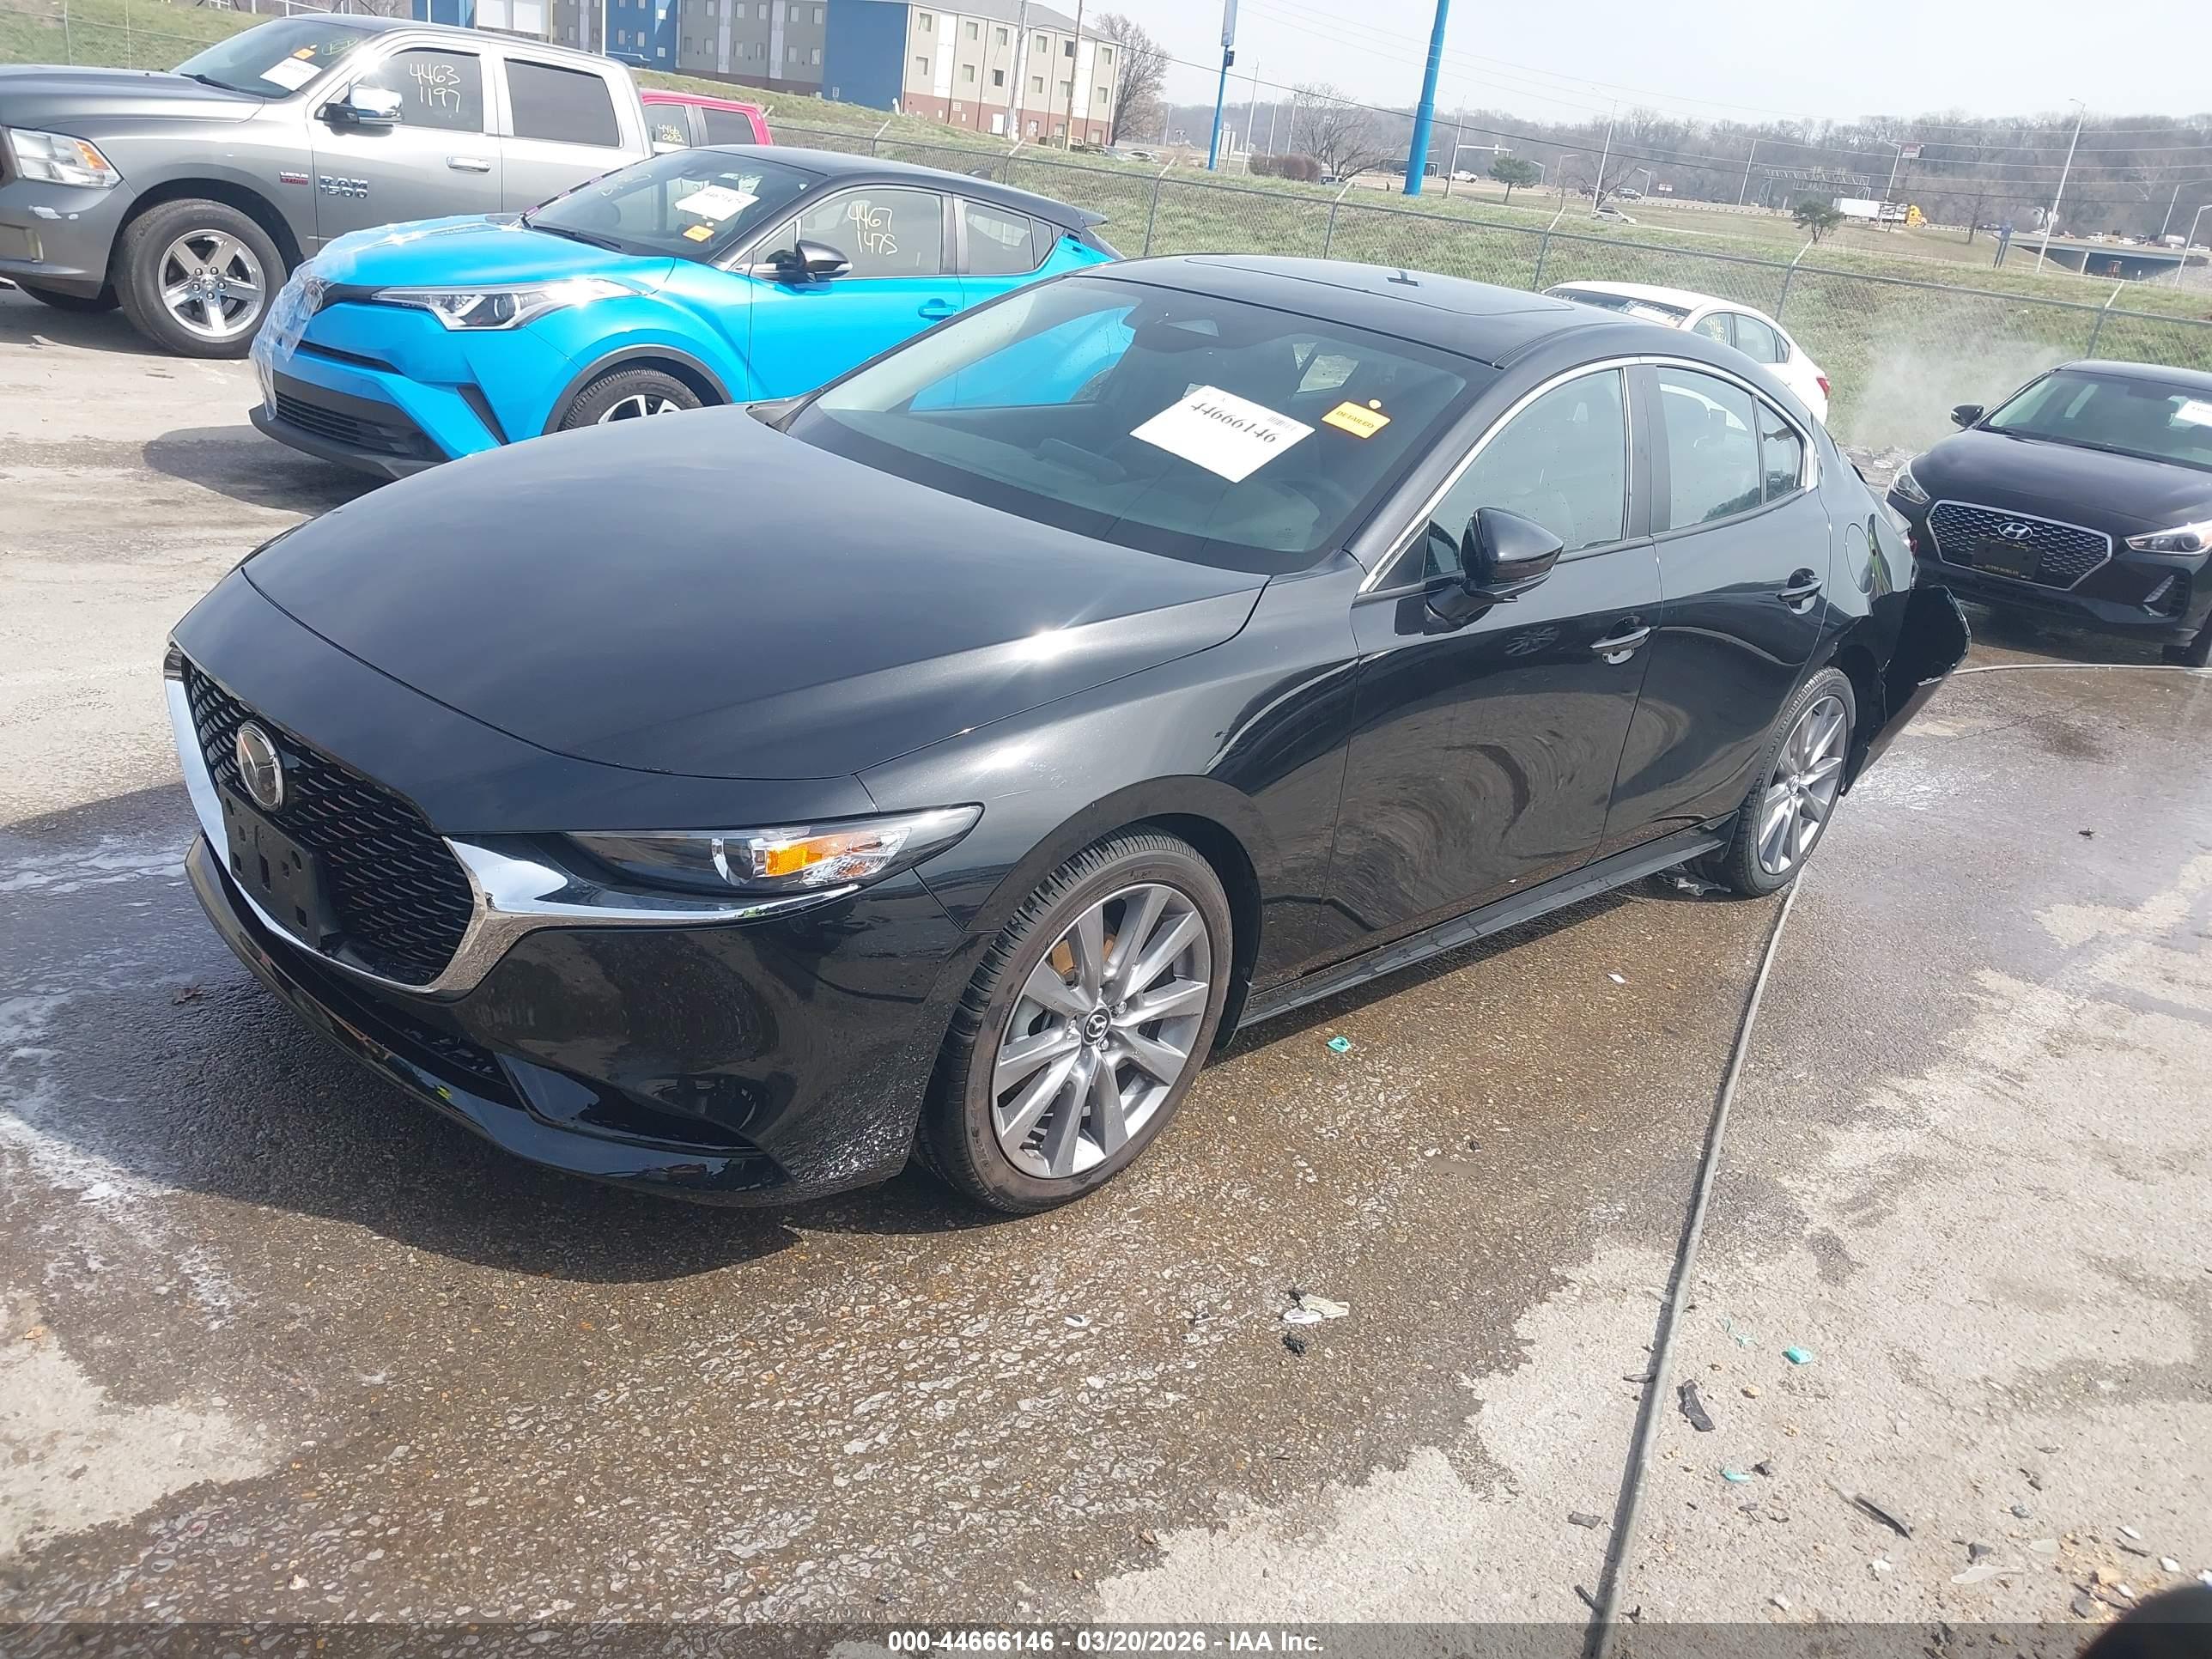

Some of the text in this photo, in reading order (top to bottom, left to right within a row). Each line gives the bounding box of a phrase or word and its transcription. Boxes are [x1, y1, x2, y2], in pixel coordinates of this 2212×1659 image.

[410, 63, 461, 86] 4463
[420, 86, 461, 113] 1197
[319, 174, 368, 190] RAM
[319, 184, 368, 199] 1500
[847, 204, 893, 234] 4467
[857, 230, 898, 256] 1475
[1190, 402, 1279, 443] 44666146
